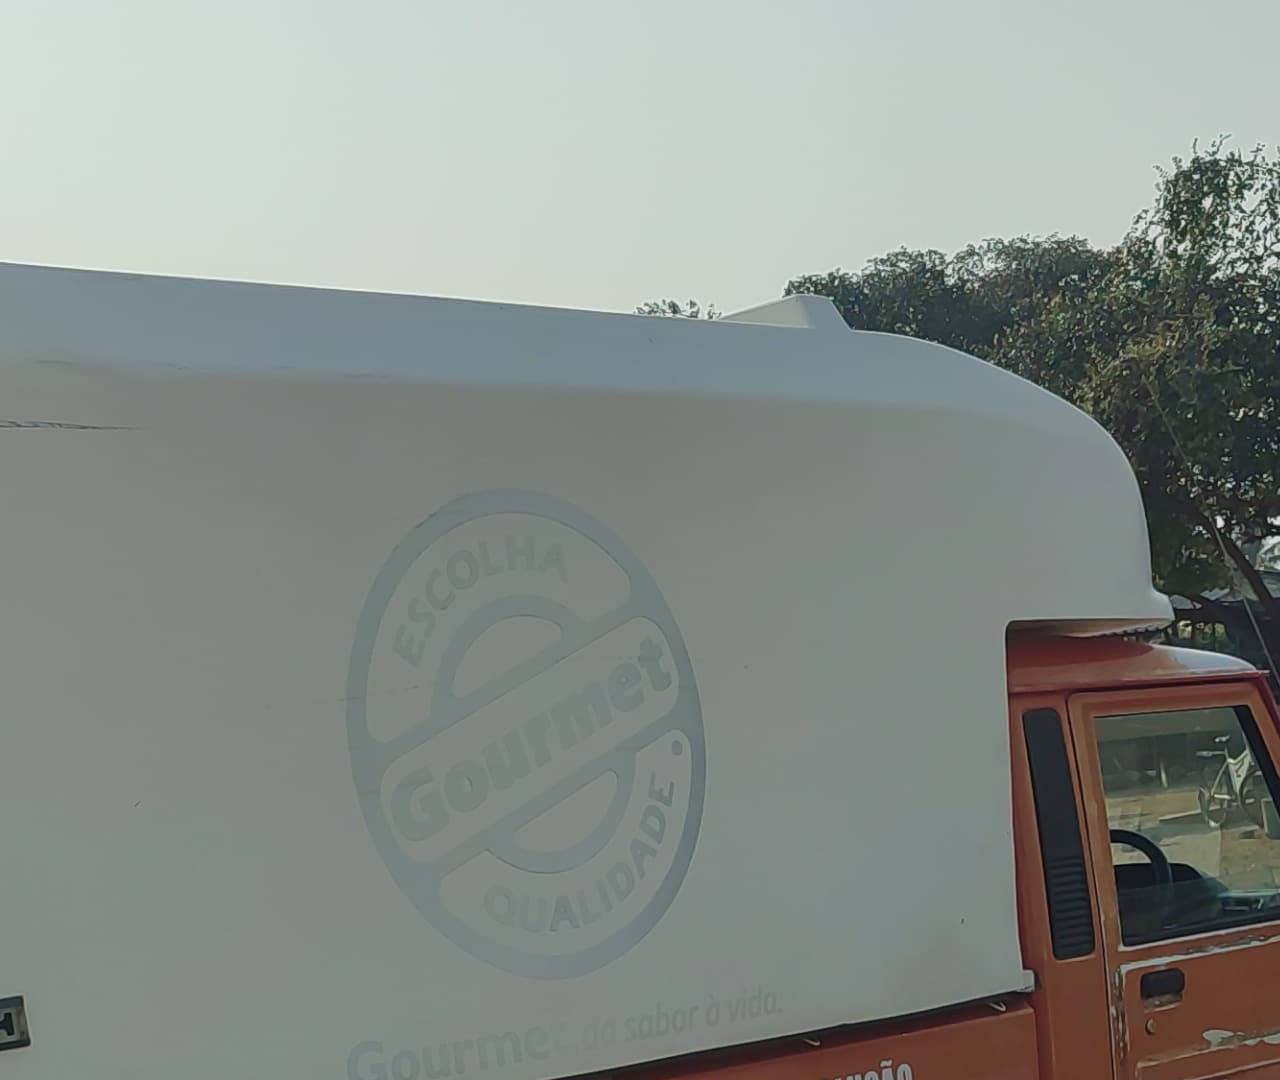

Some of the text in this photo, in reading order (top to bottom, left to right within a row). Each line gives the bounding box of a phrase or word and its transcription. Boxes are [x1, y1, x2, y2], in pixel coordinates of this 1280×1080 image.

[392, 535, 569, 667] ESCOLHA
[391, 634, 673, 842] Gourmet
[482, 771, 674, 932] QUALIDADE
[623, 1003, 700, 1042] sabor
[726, 984, 784, 1022] vida.
